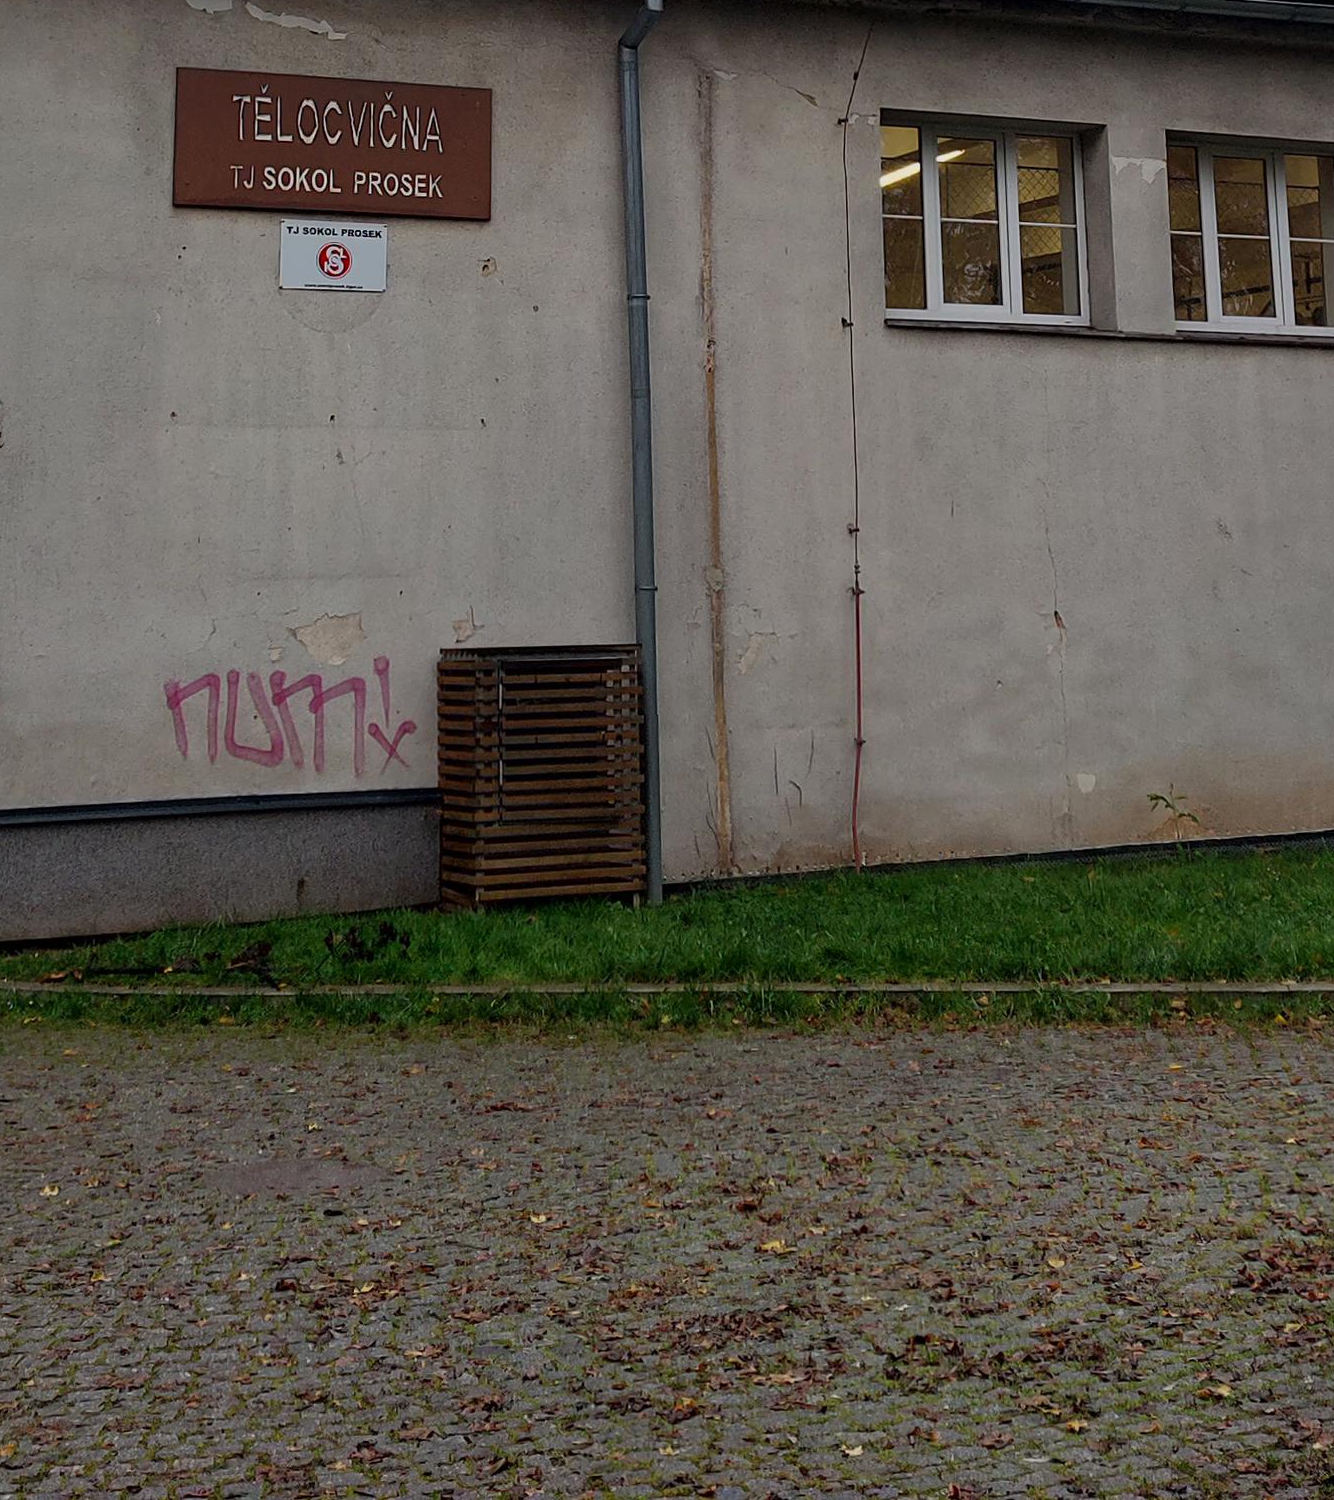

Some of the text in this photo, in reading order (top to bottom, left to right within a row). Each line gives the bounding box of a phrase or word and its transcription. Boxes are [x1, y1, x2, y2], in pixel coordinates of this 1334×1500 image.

[232, 84, 443, 153] TĚLOCVIČNA
[230, 165, 444, 199] TJ SOKOL PROSEK
[287, 226, 383, 240] TJ SOKOL PROSEK
